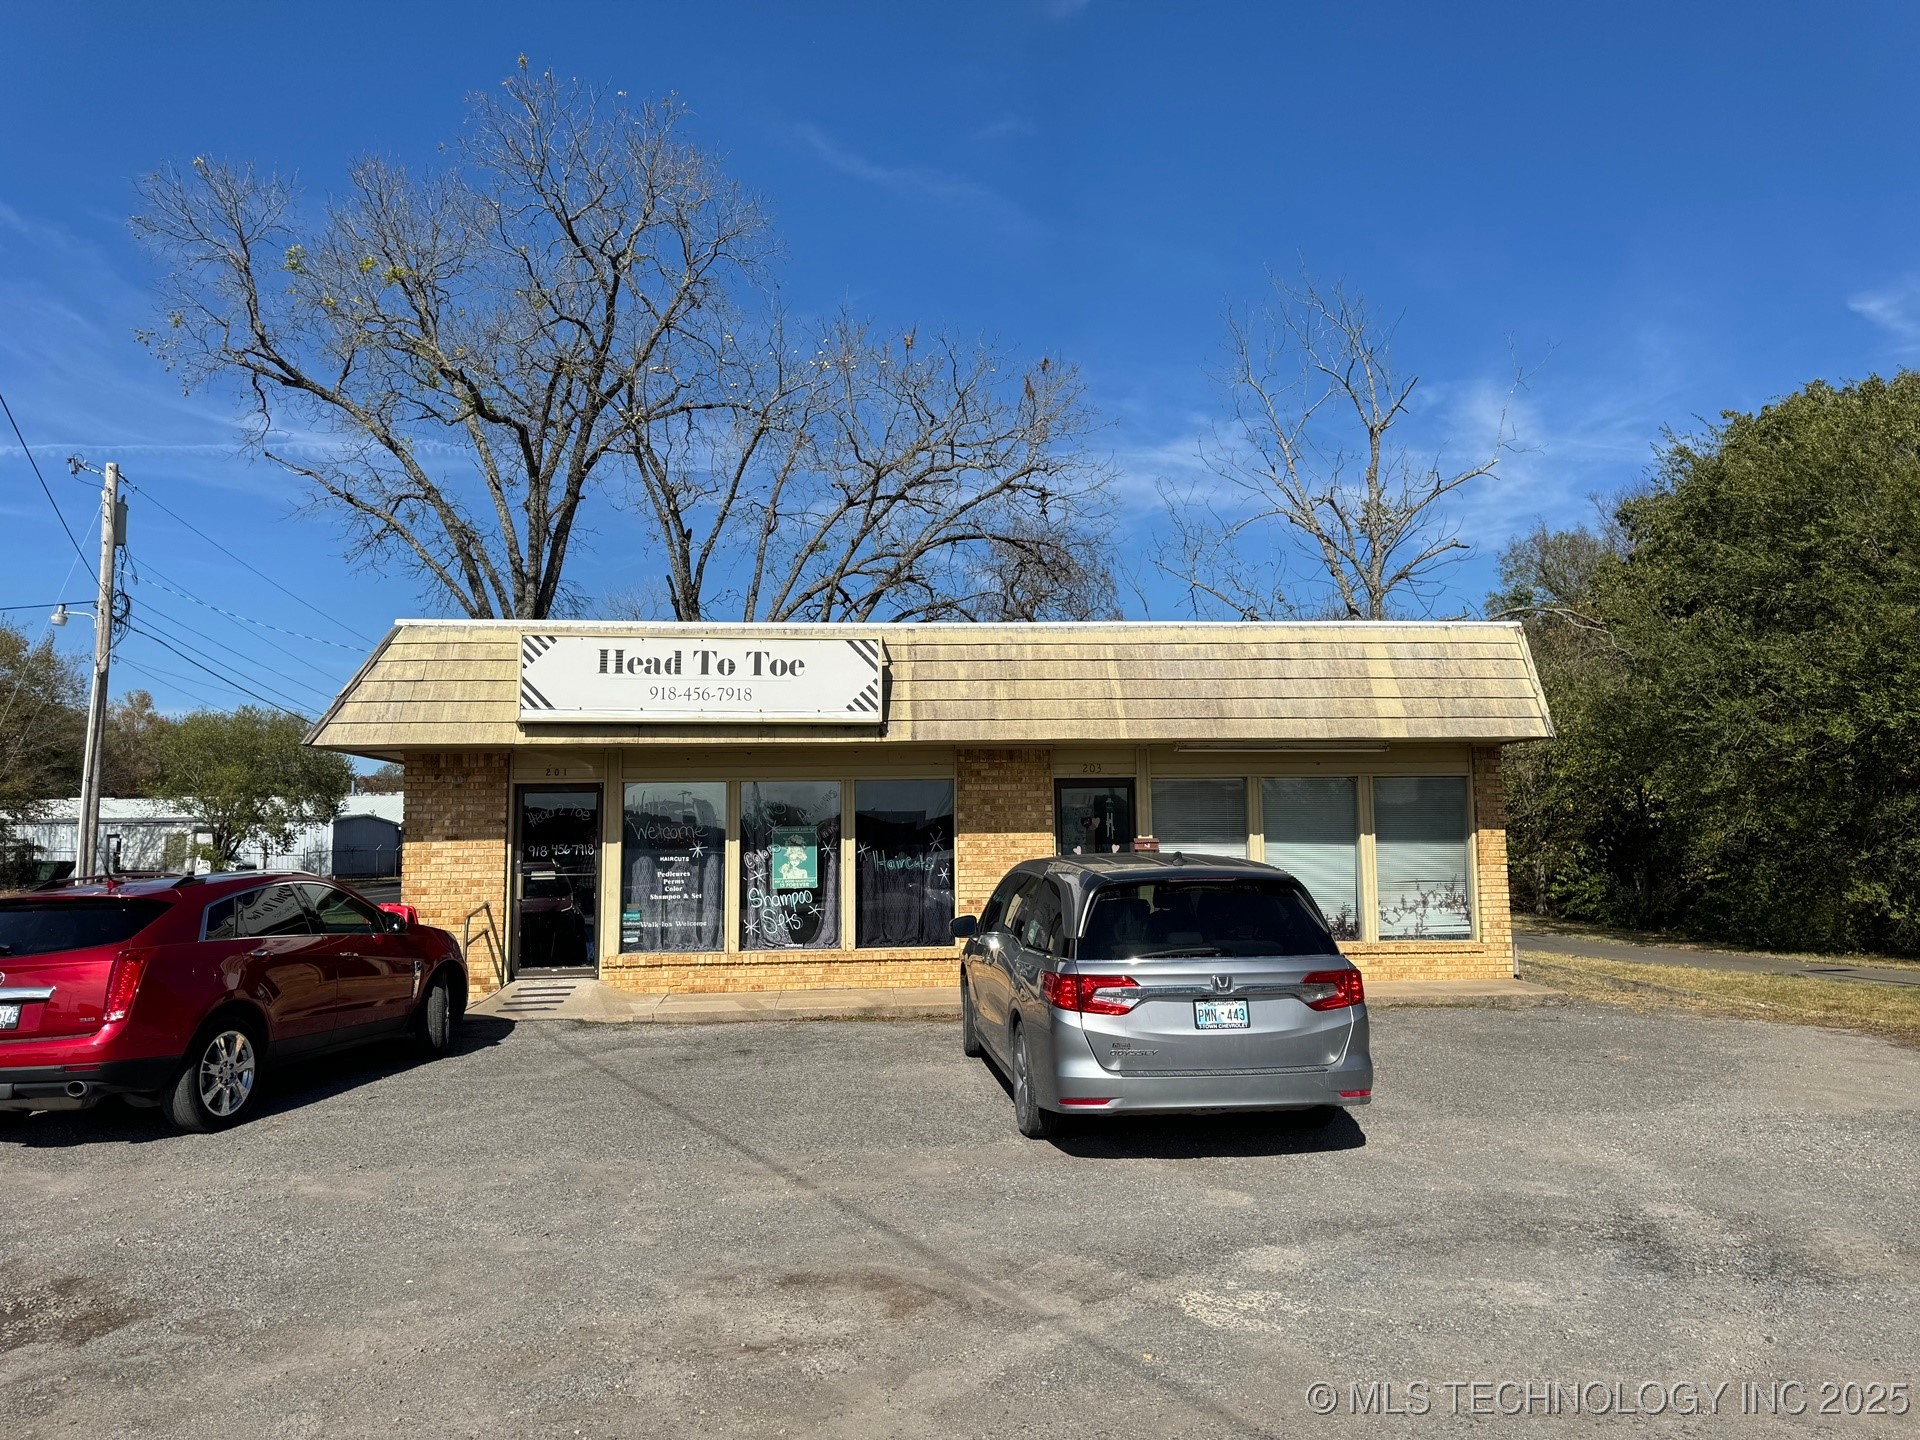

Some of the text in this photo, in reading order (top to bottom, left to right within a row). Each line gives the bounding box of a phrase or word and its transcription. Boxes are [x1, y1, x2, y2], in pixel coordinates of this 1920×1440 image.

[598, 649, 806, 677] Head To Toe
[649, 686, 753, 702] 918-456-7918
[545, 768, 568, 776] 201
[1082, 764, 1102, 774] 203
[630, 820, 709, 840] Welcome
[748, 887, 813, 912] Shampoo
[761, 908, 804, 933] Sets
[1226, 1007, 1245, 1021] 443
